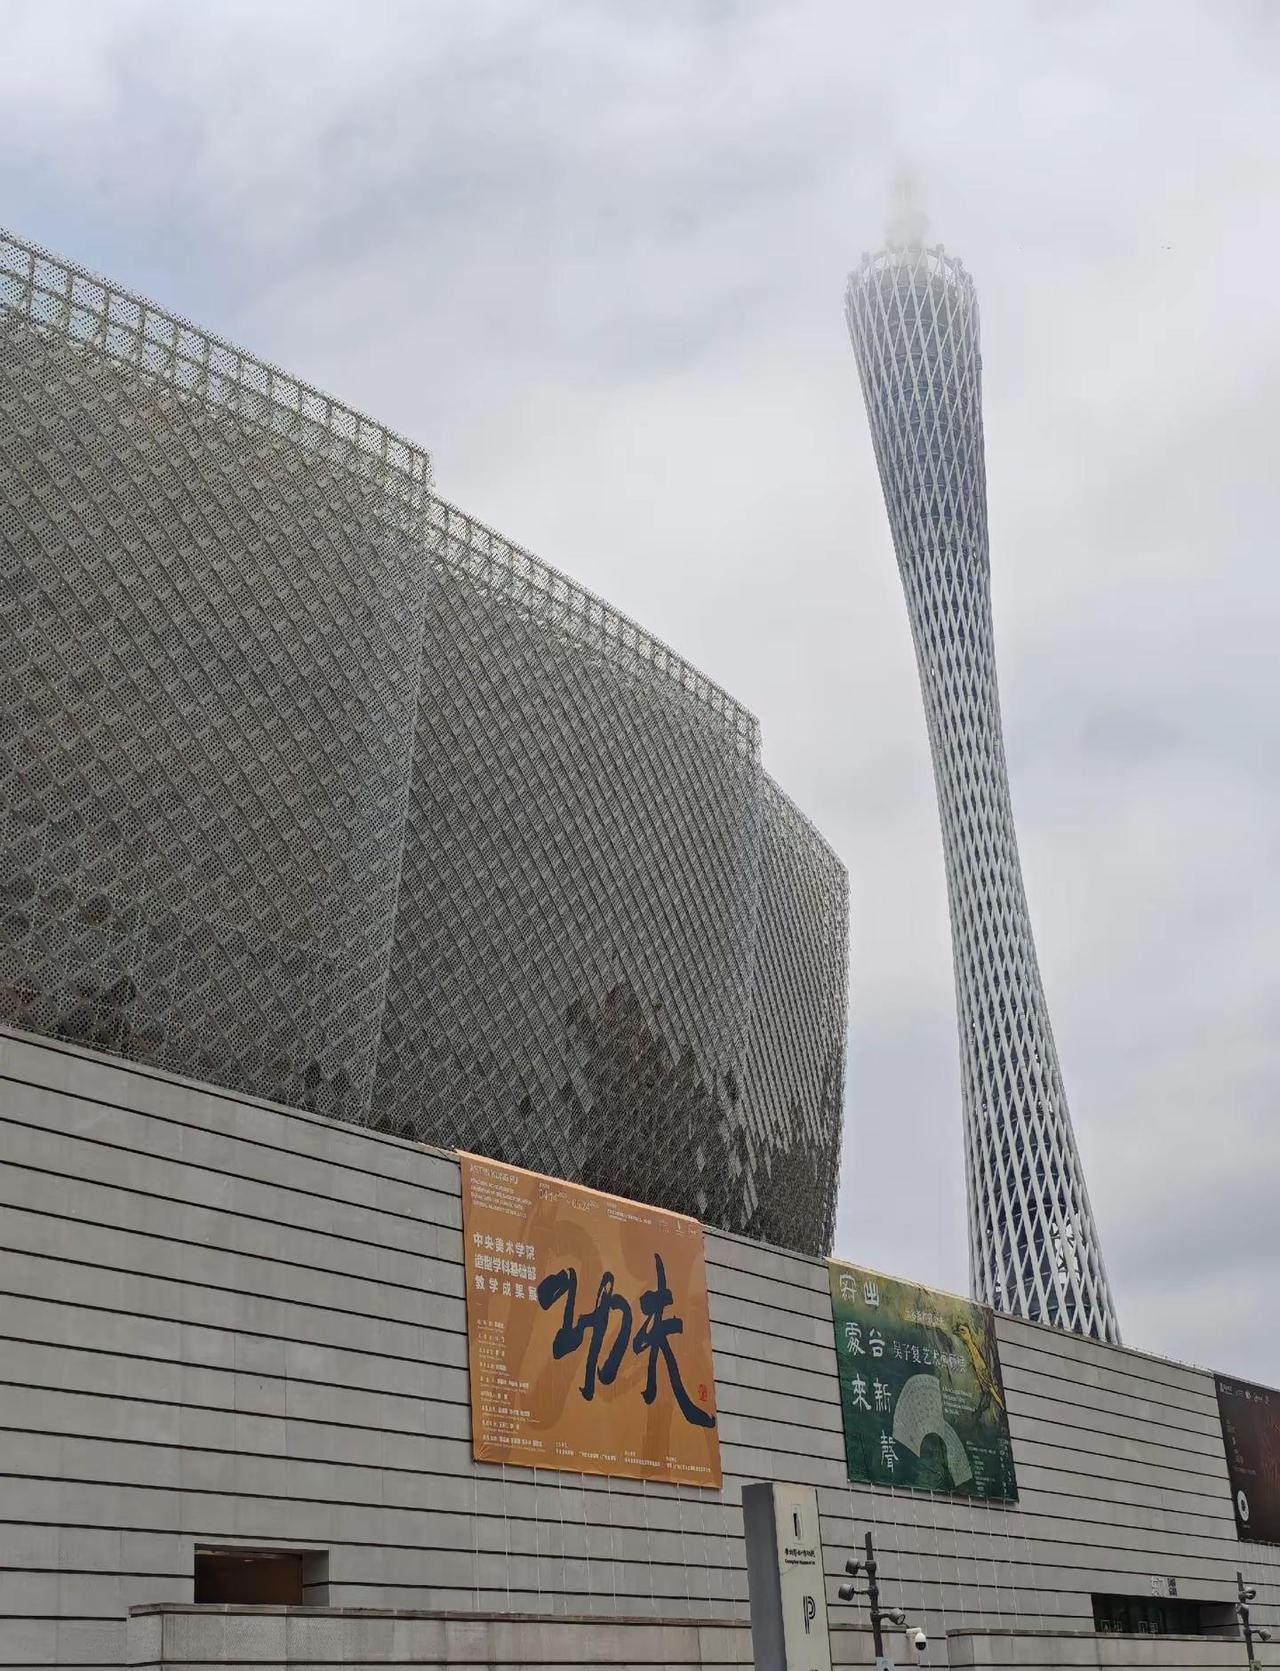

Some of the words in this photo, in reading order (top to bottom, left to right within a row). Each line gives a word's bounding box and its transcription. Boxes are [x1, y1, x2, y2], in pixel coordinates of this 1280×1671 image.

[473, 1231, 535, 1261] 中央美术学院
[474, 1252, 537, 1281] 造型学科基础部
[474, 1273, 538, 1303] 教学成果展
[537, 1252, 716, 1428] 功夫
